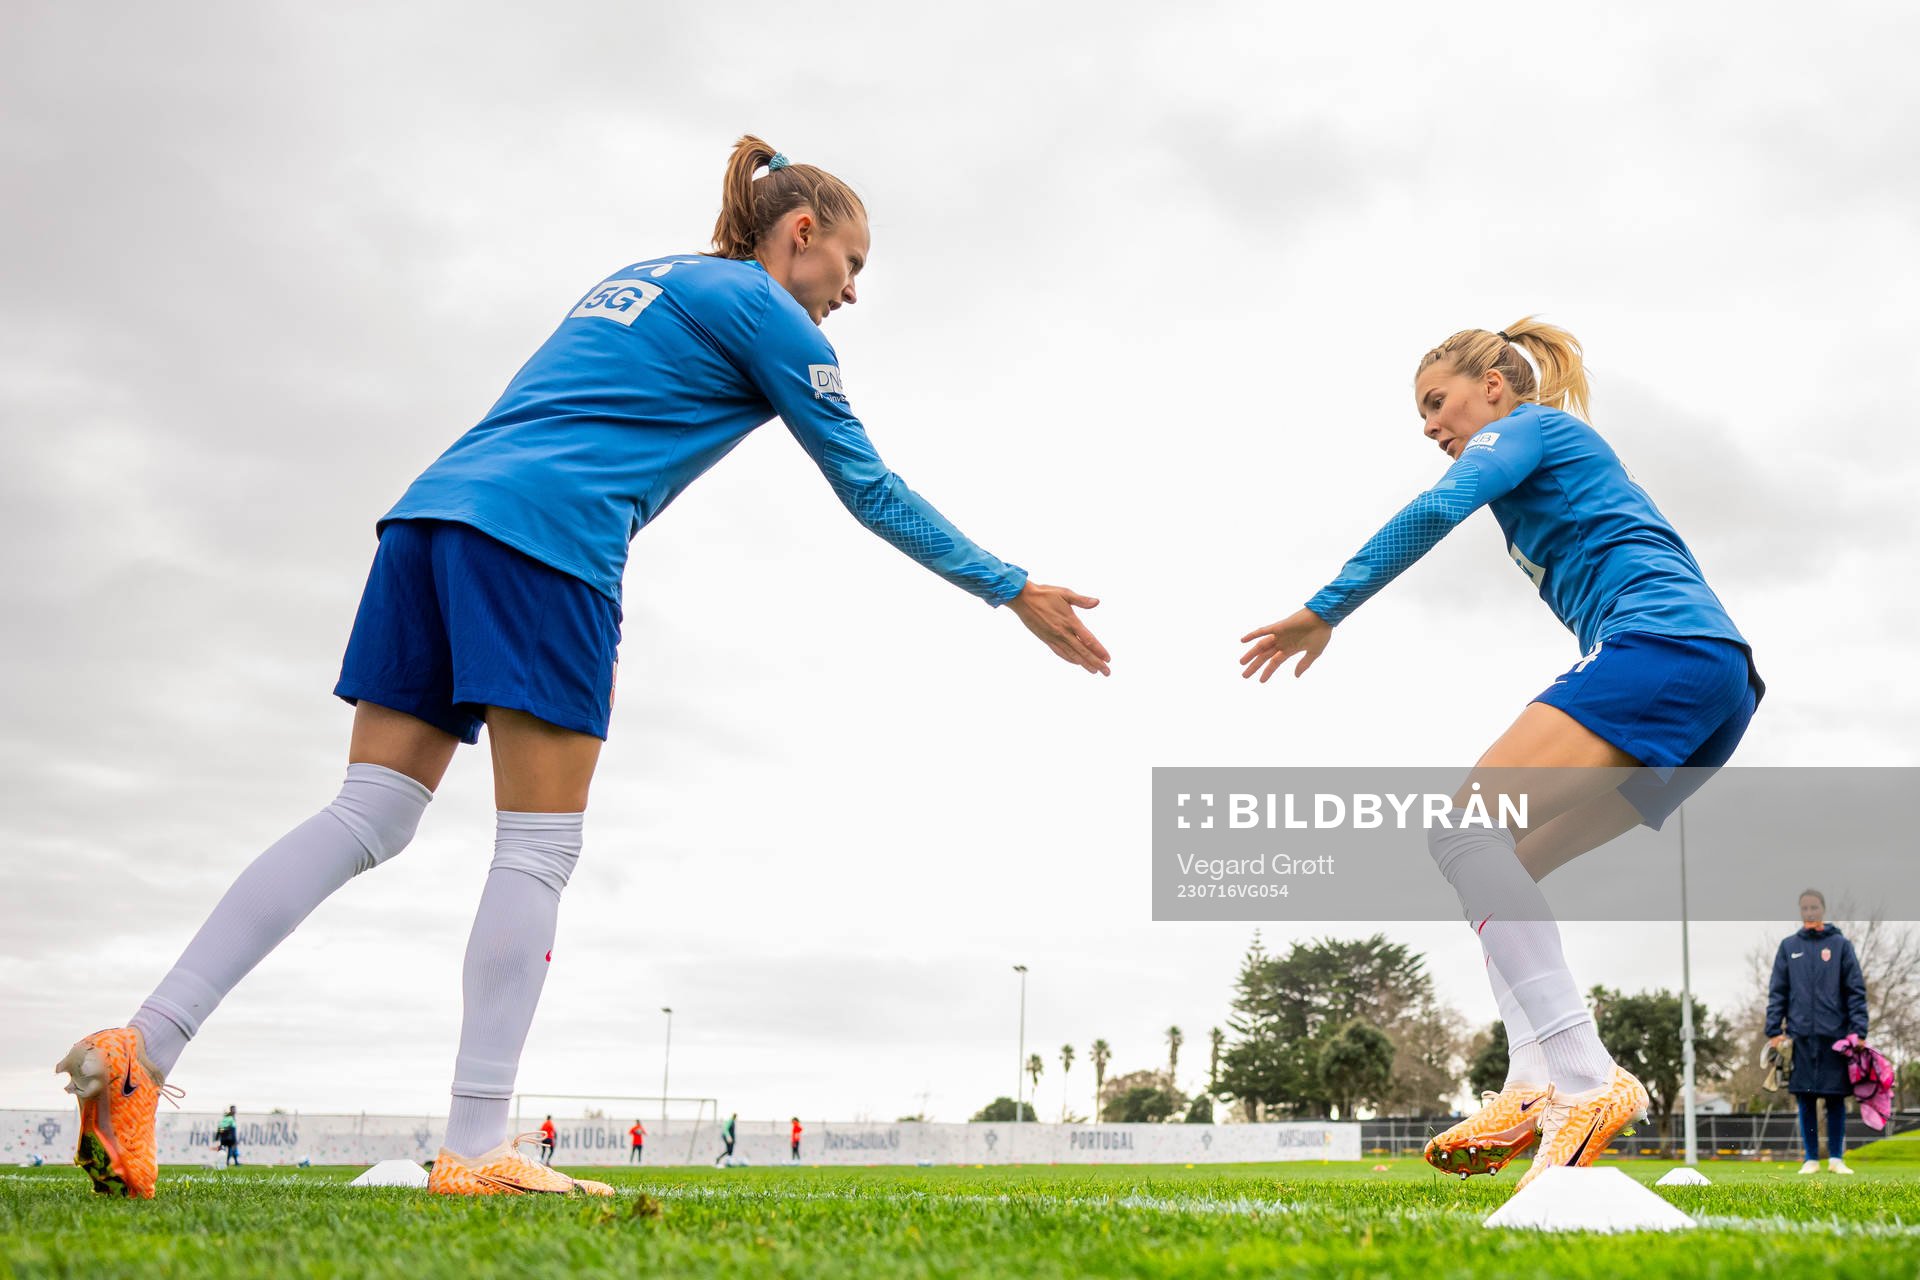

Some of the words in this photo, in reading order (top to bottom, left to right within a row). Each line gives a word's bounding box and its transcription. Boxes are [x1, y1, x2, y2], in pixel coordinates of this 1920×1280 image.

[585, 286, 643, 312] 5G
[816, 370, 843, 392] DN
[558, 1125, 626, 1150] RTUGAL
[1070, 1131, 1134, 1150] PORTUGAL
